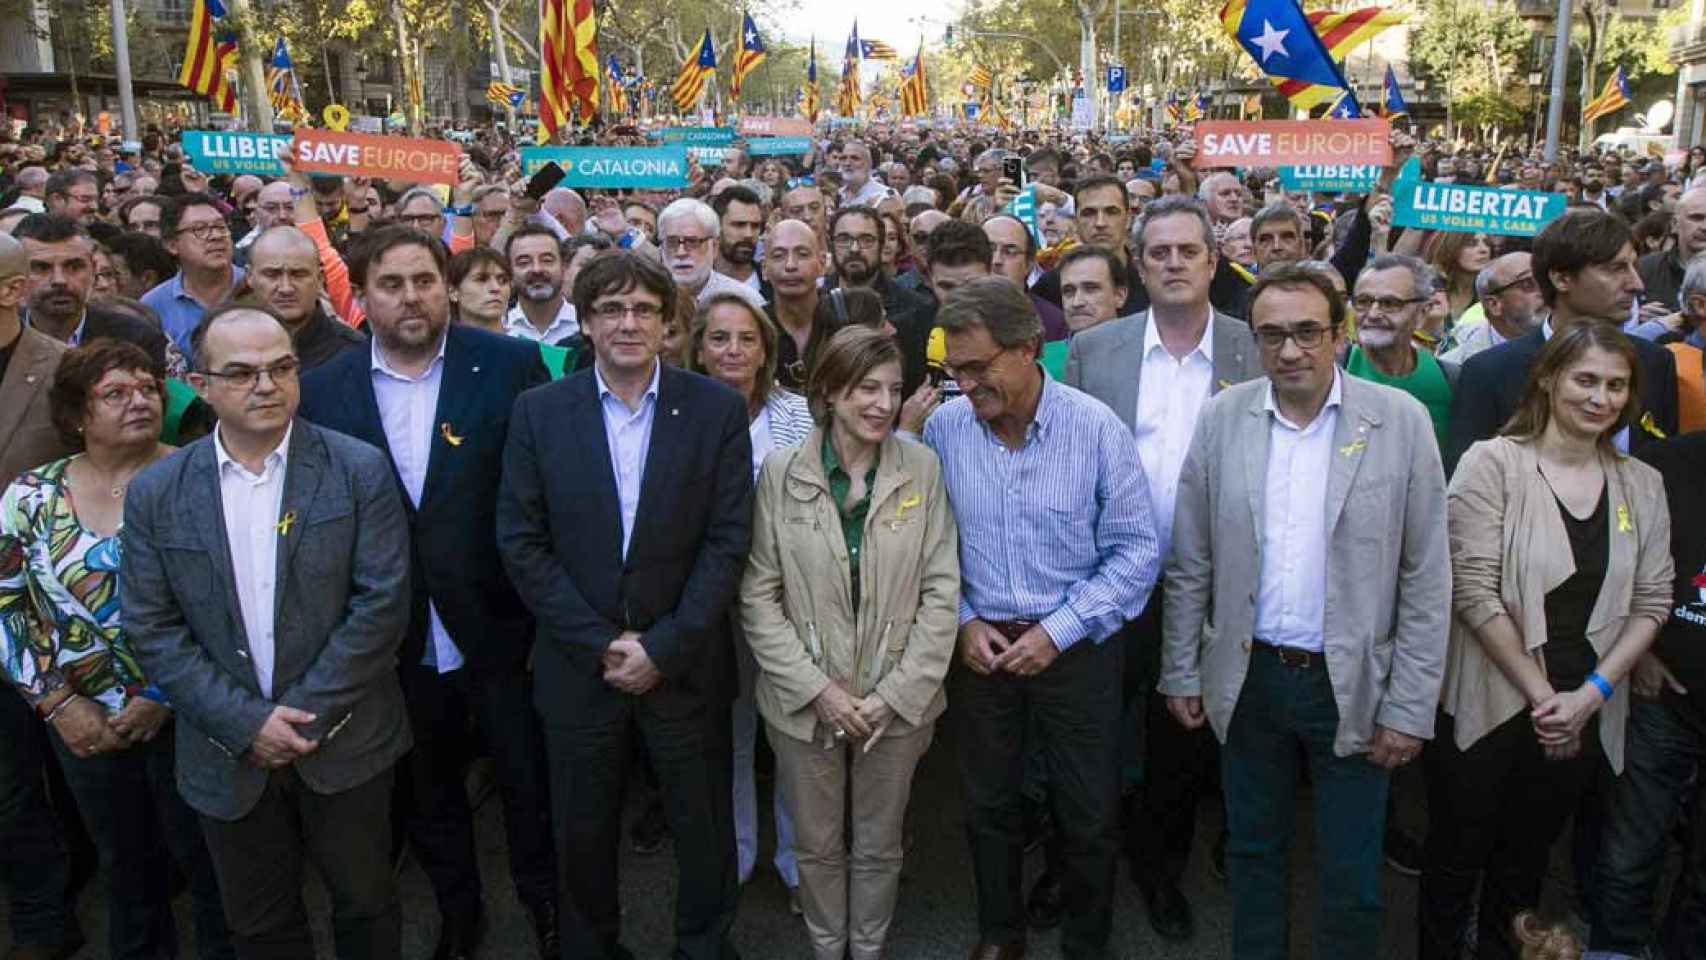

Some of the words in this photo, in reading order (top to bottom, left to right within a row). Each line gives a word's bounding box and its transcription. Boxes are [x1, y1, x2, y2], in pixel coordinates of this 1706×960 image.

[1110, 68, 1122, 83] P
[202, 135, 292, 160] LLIBER
[1203, 133, 1272, 156] SAVE
[1277, 132, 1384, 156] EUROPE
[299, 141, 360, 166] SAVE
[362, 146, 456, 174] EUROPE
[577, 159, 680, 177] CATALONIA
[1293, 164, 1383, 179] LLIBERT
[1412, 186, 1549, 220] LLIBERTAT
[1420, 213, 1437, 225] US
[1441, 215, 1484, 229] VOLEM
[1488, 219, 1499, 230] A
[1502, 219, 1537, 233] CASA
